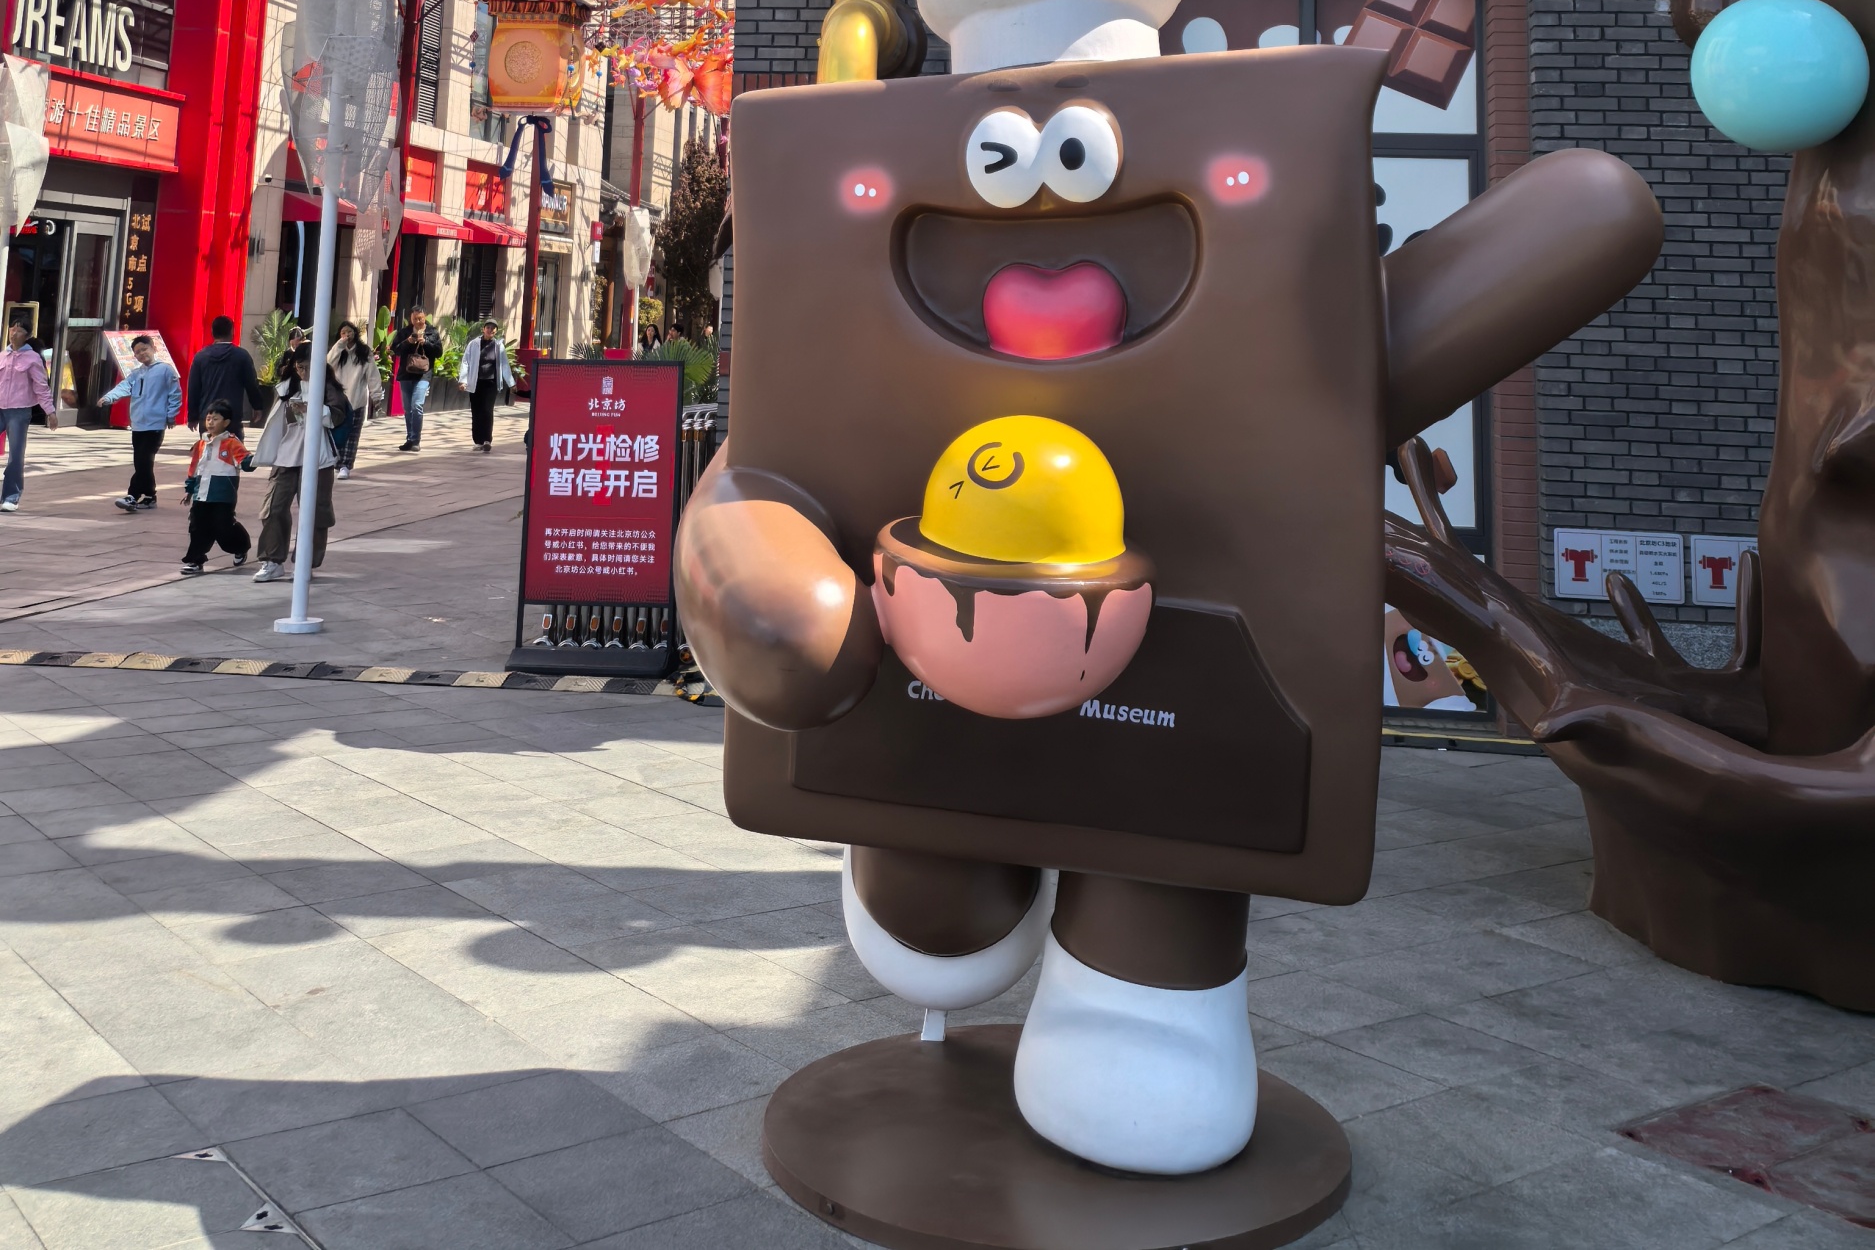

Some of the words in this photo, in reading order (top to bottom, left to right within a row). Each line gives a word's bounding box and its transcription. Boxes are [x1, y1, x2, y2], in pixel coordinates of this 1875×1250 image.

[44, 97, 162, 141] 游十佳精品景区
[588, 397, 626, 411] 北京坊
[549, 433, 660, 463] 灯光检修
[548, 468, 658, 498] 暂停开启
[1080, 699, 1175, 728] Museum
